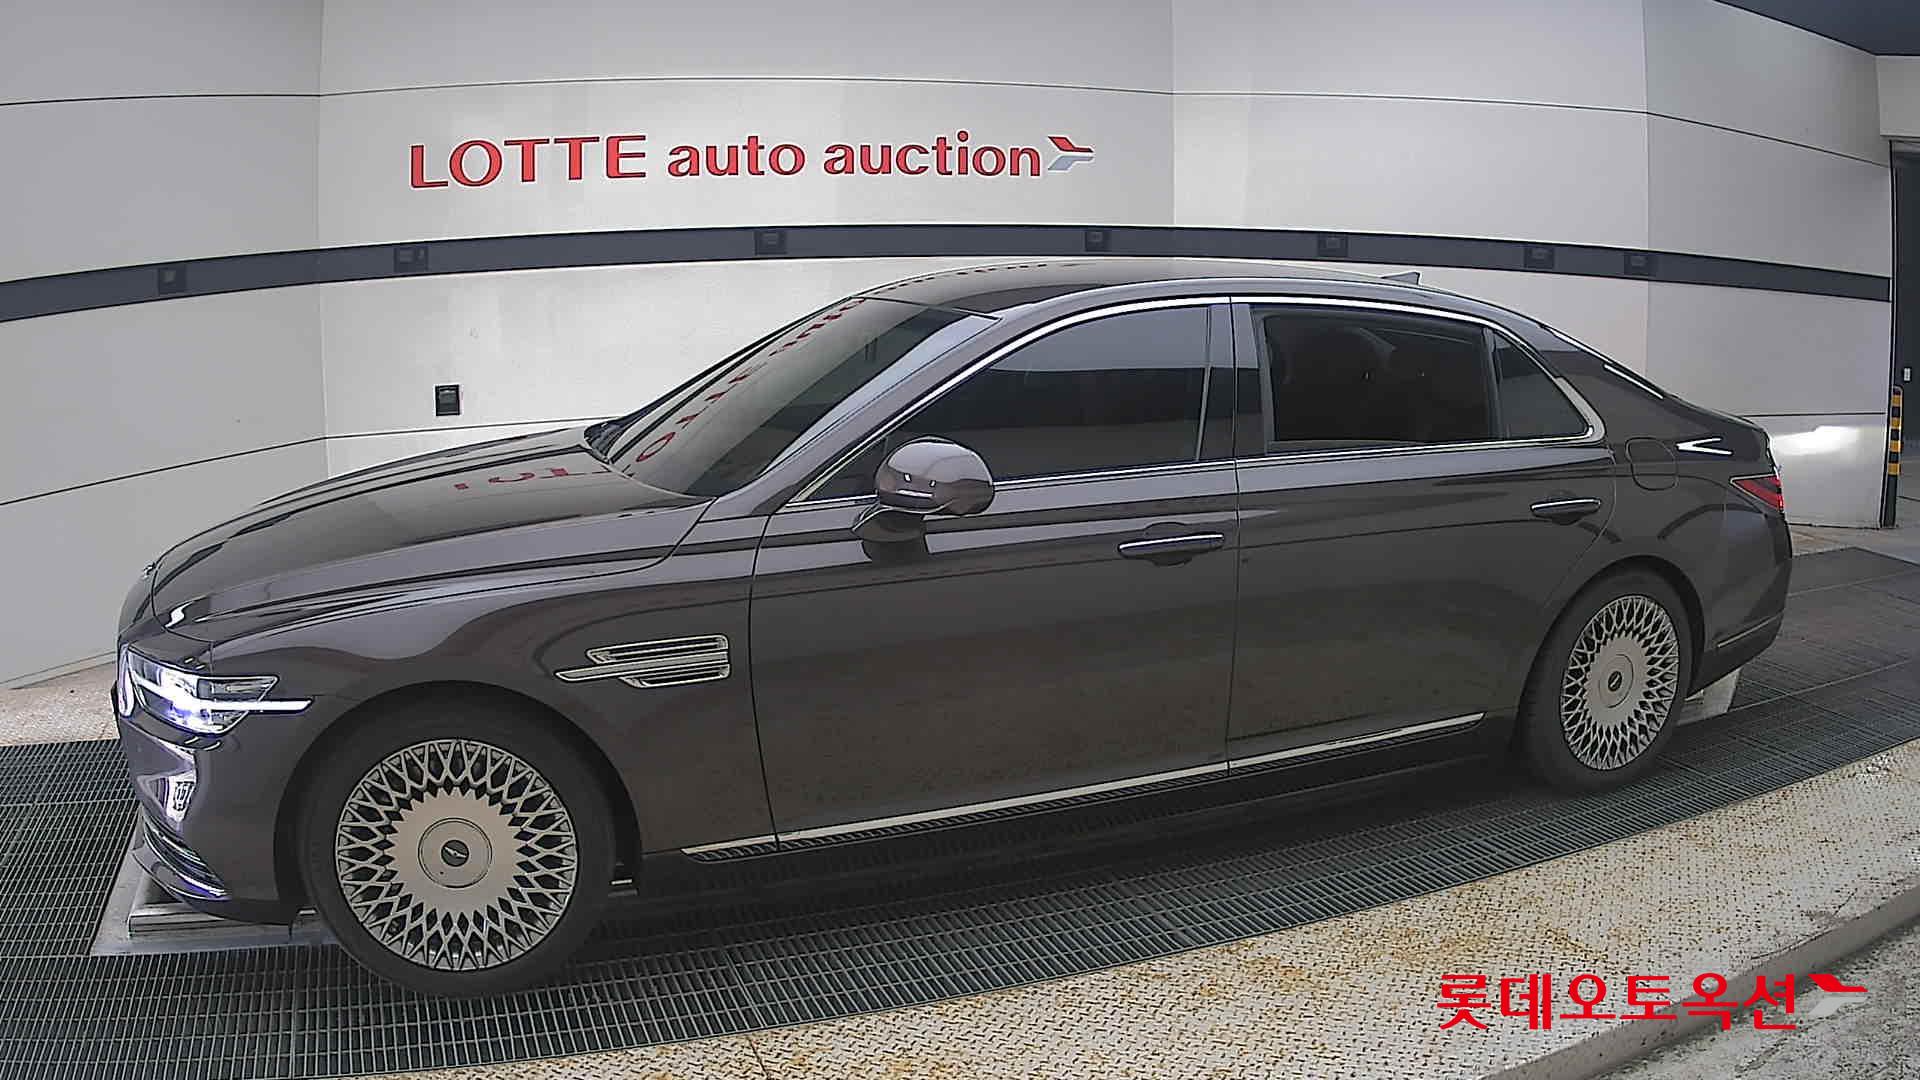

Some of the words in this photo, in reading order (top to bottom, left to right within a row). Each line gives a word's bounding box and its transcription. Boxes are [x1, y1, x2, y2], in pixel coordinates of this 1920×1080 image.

[411, 135, 646, 188] LOTTE
[667, 135, 805, 177] auto
[823, 131, 1041, 177] auction
